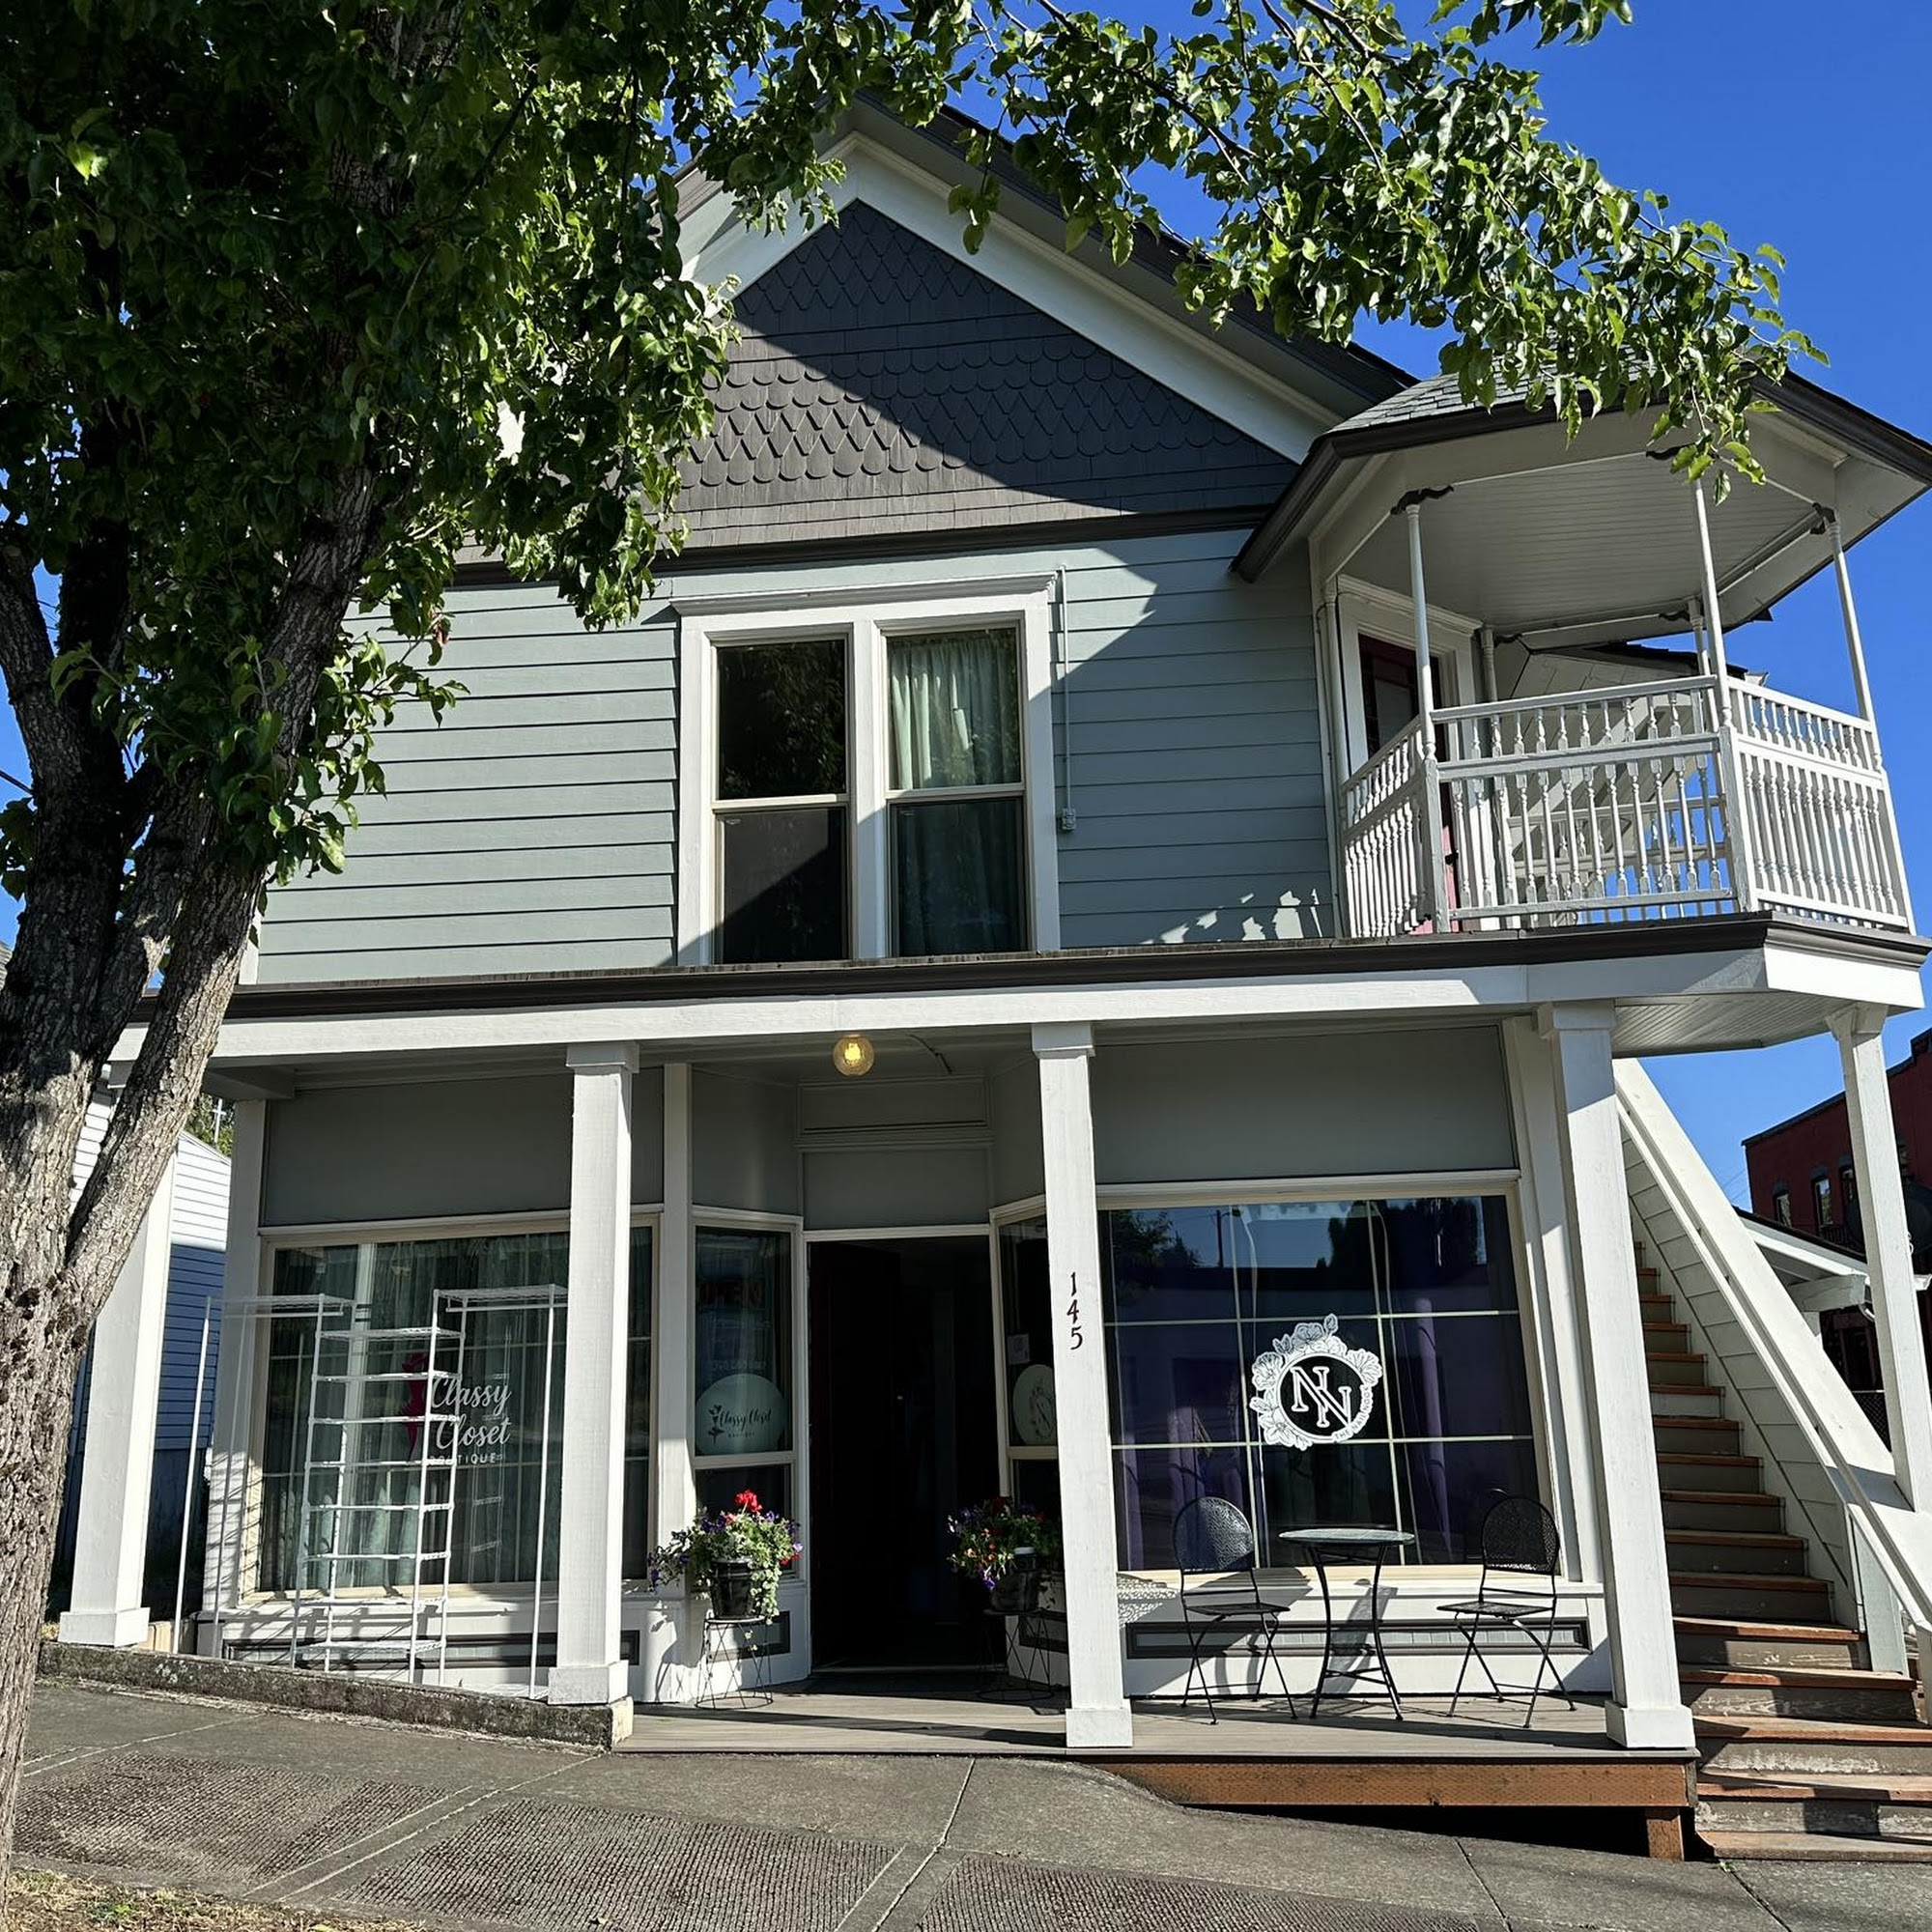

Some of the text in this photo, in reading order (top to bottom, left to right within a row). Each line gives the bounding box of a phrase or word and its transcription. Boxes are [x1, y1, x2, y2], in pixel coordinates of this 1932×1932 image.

[1066, 1271, 1083, 1350] 145
[432, 1376, 512, 1416] Classy
[437, 1413, 512, 1449] Closet
